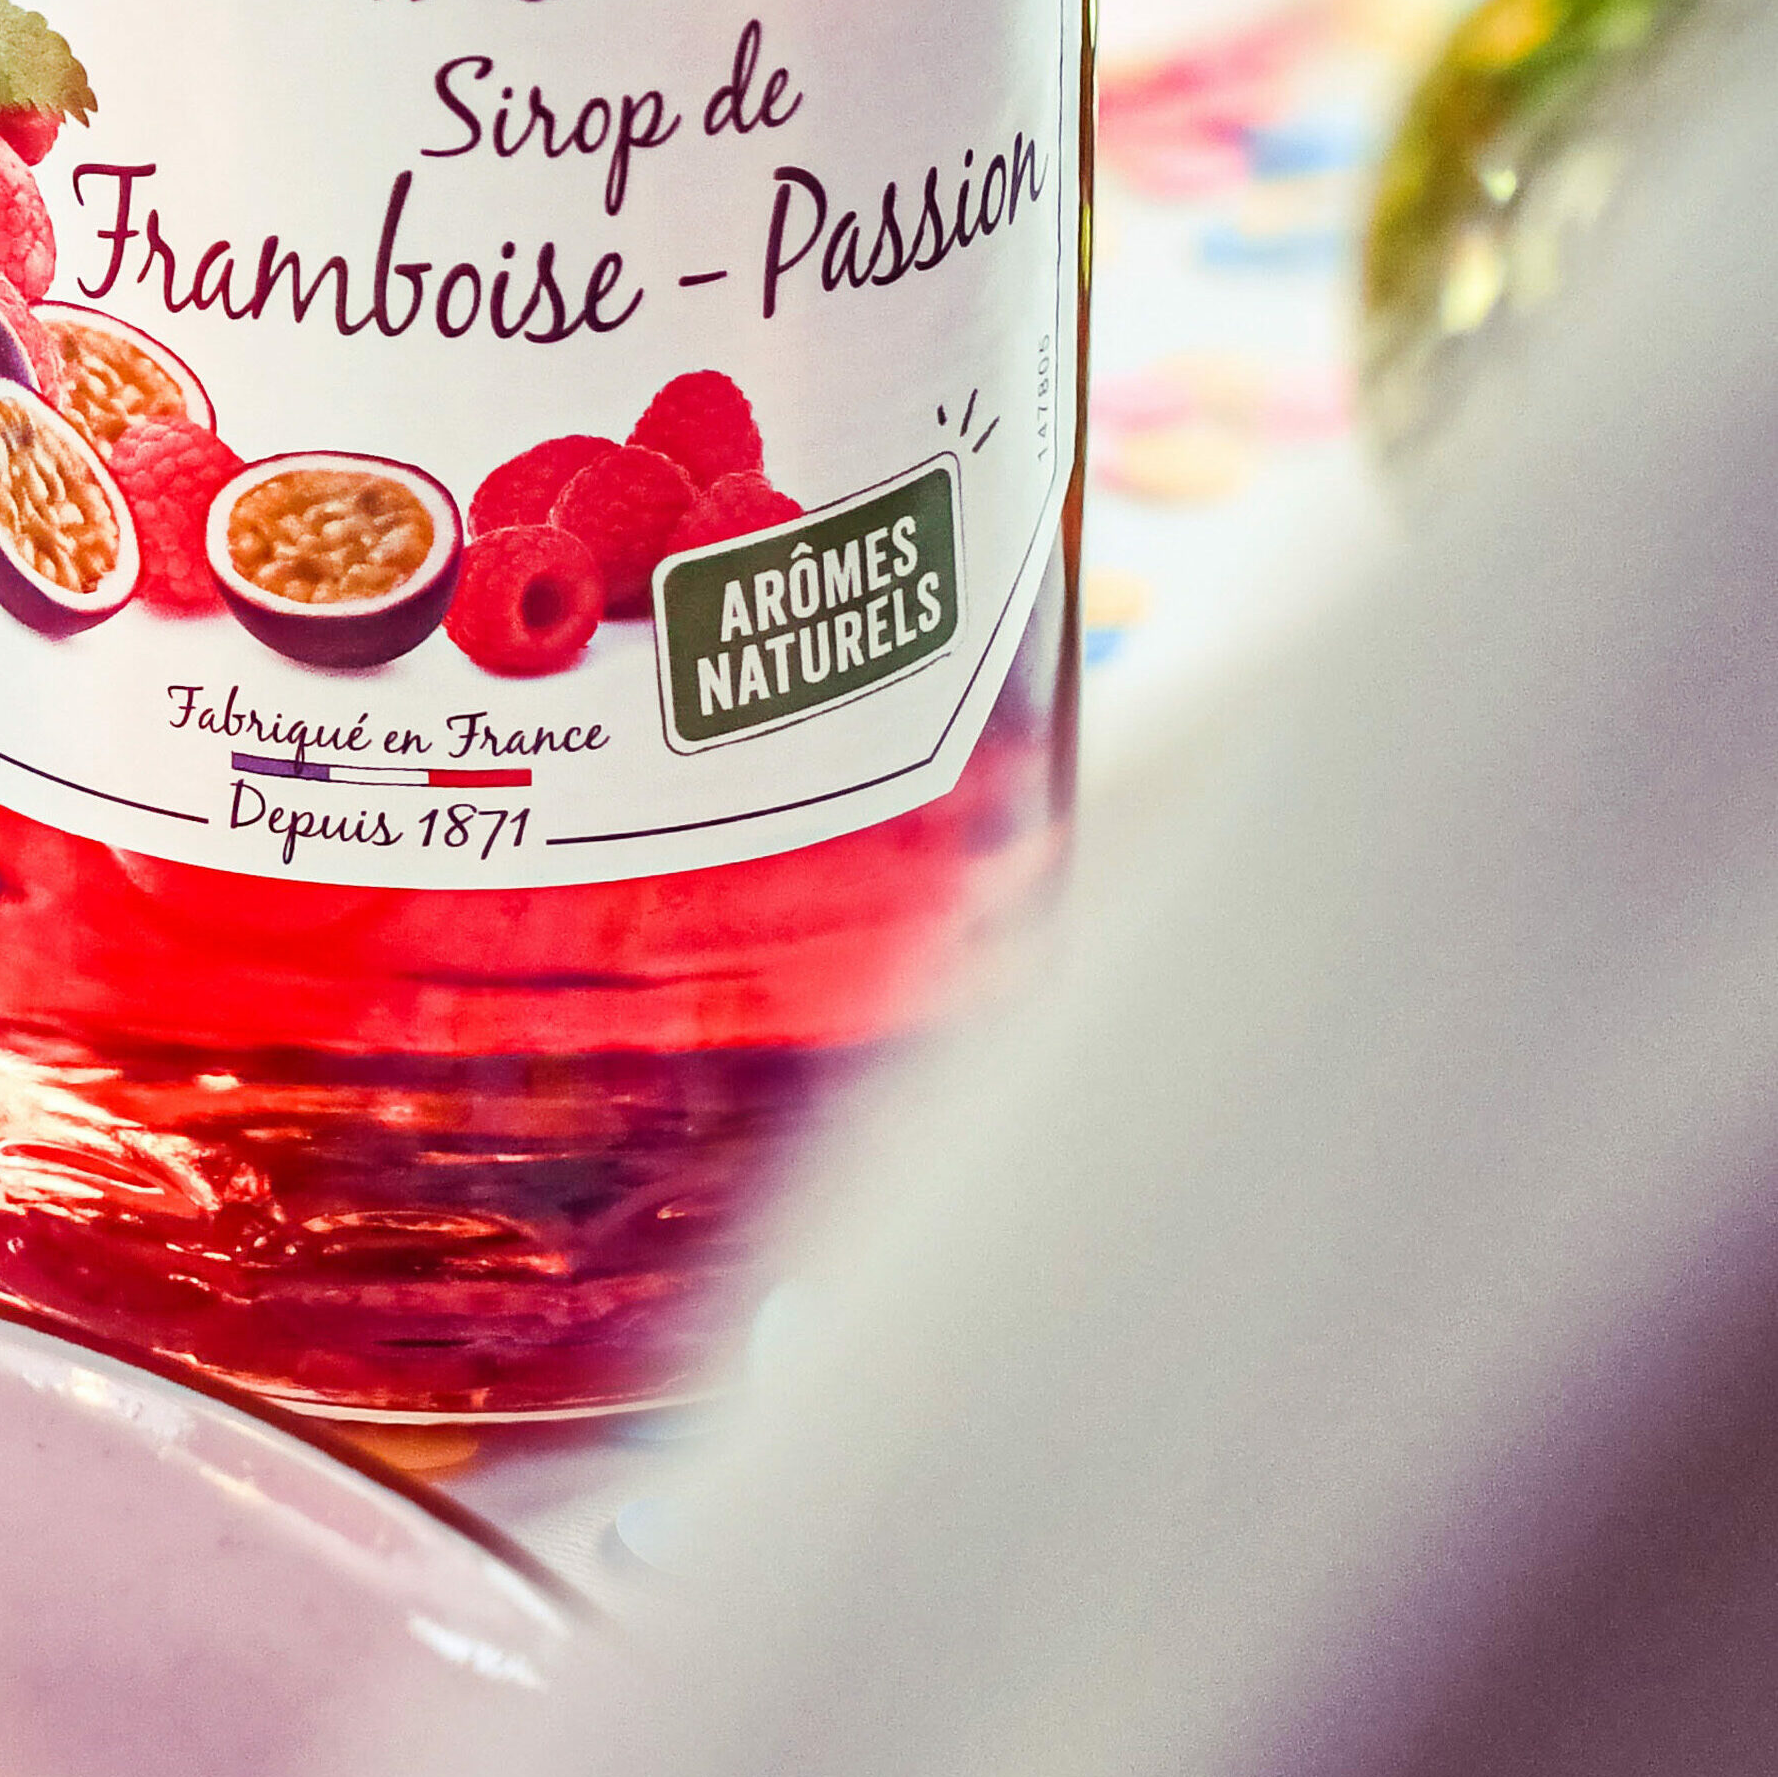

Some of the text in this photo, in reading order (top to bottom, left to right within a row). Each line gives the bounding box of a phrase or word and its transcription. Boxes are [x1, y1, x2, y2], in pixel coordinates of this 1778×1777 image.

[422, 19, 801, 215] Sirop de
[74, 164, 644, 342] Framboise
[761, 130, 1047, 320] Passion
[695, 571, 943, 715] NATURELS
[718, 516, 922, 641] ARÔMES
[166, 685, 610, 773] Fabriqué en France
[230, 779, 530, 865] Depuis 1871
